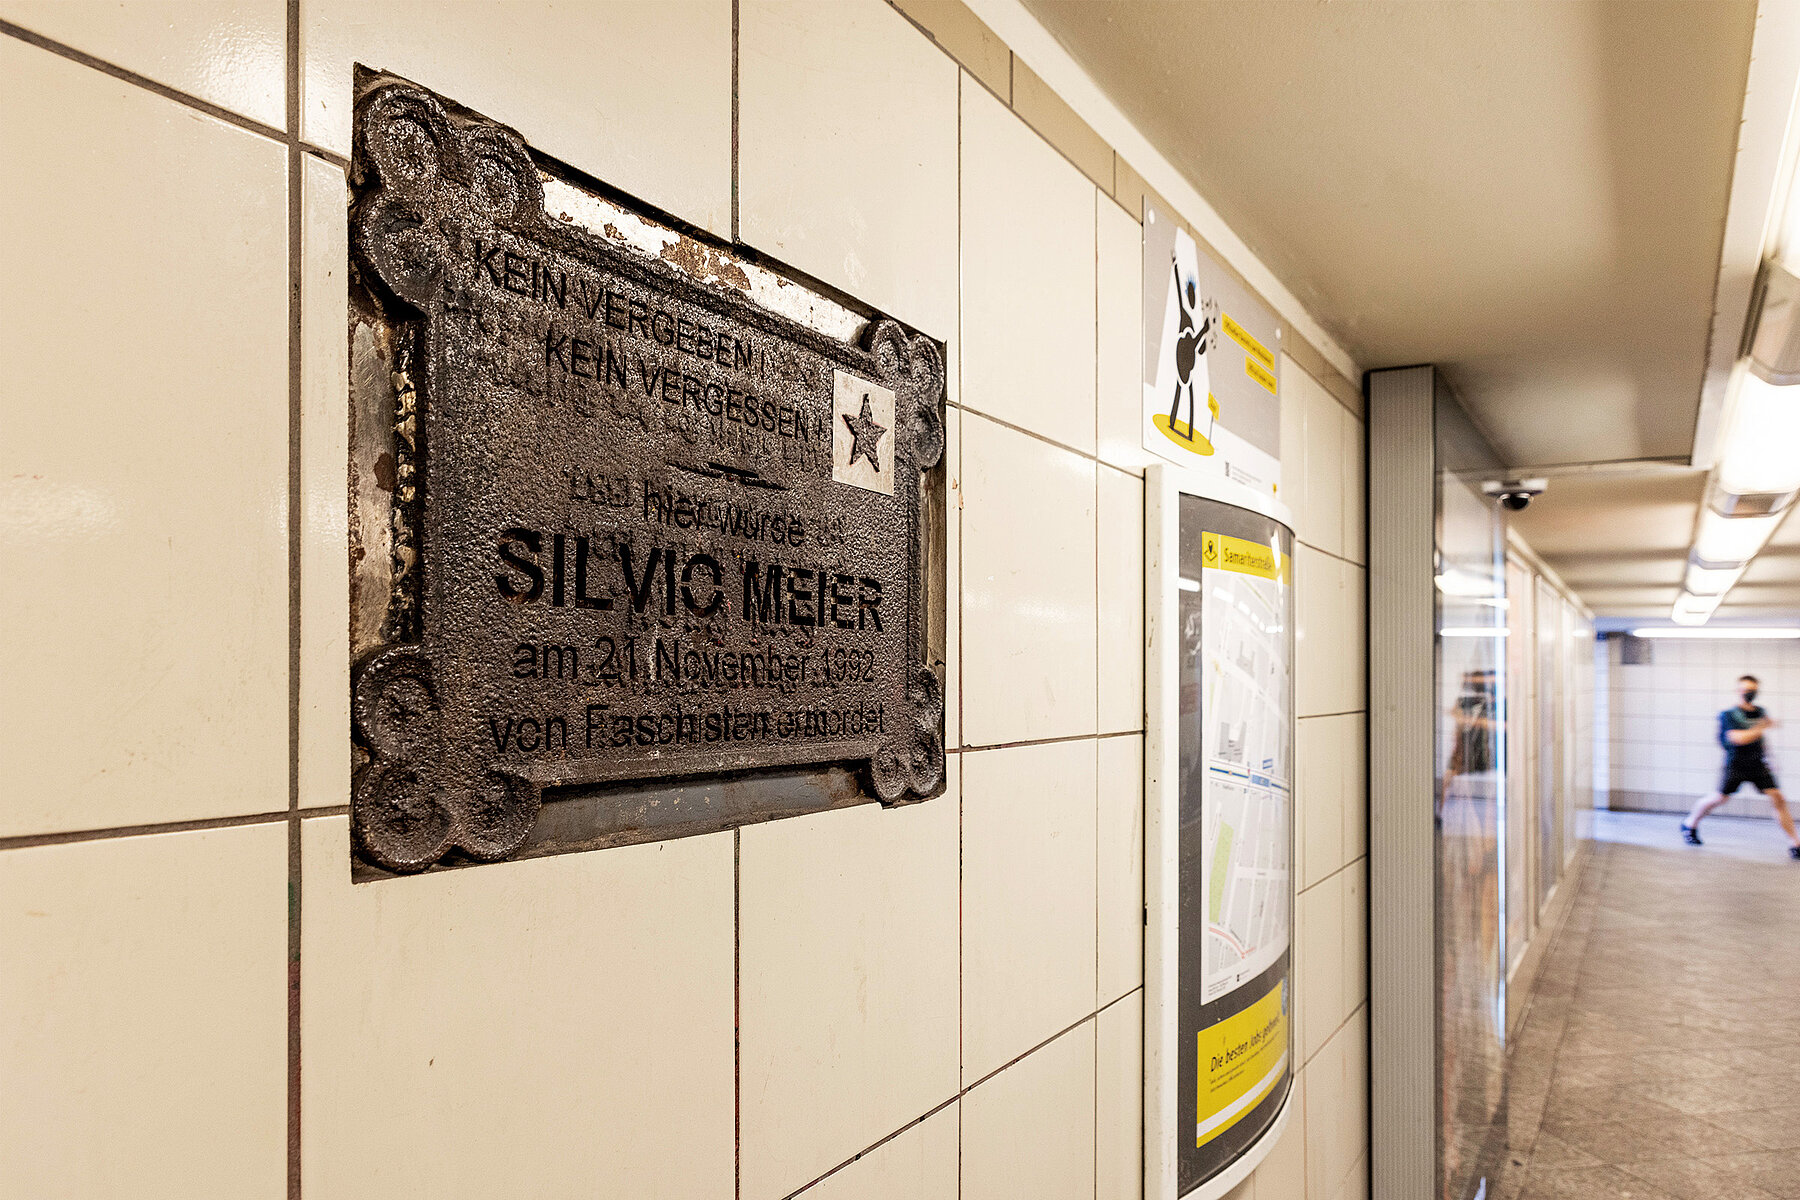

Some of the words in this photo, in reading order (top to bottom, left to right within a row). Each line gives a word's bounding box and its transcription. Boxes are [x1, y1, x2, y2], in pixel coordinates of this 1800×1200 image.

[475, 240, 566, 309] KEIN
[580, 279, 753, 370] VERGEBEN
[546, 328, 628, 391] KEIN
[643, 359, 809, 441] VERGESSEN
[644, 480, 706, 529] hier
[497, 526, 724, 618] SILVIO
[743, 563, 883, 633] MEIER
[513, 642, 579, 680] am
[656, 639, 811, 682] November
[822, 647, 876, 683] 1992
[488, 717, 567, 754] von
[587, 704, 768, 749] Faschisten
[776, 704, 885, 740] ermordet
[1210, 1054, 1223, 1072] Die
